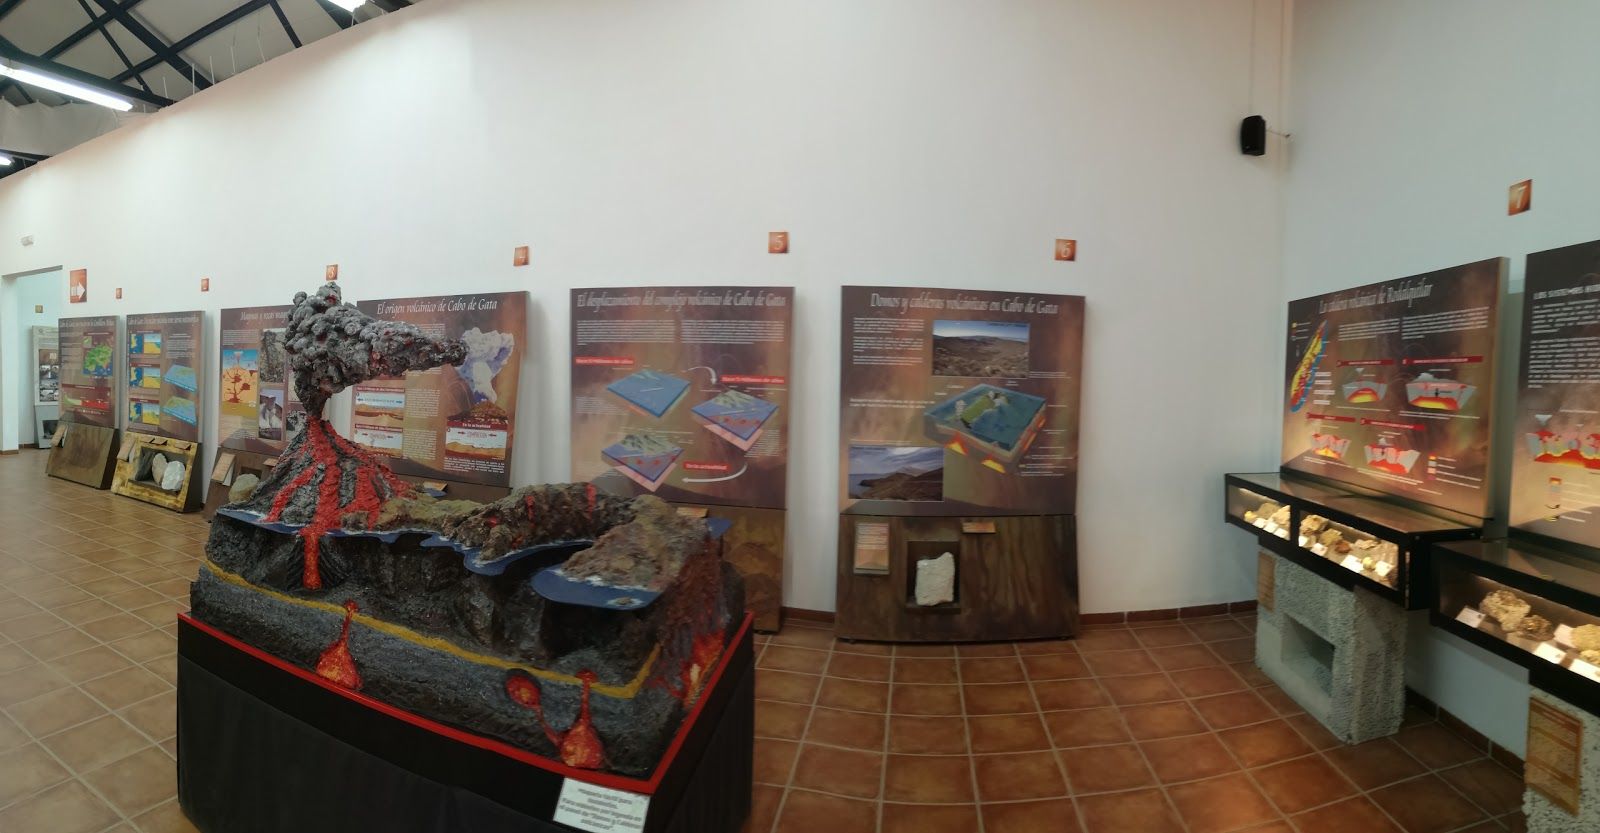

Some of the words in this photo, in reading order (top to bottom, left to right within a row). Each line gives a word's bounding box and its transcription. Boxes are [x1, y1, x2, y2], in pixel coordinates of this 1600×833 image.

[1514, 185, 1528, 208] 7
[774, 234, 784, 250] 5
[1061, 241, 1073, 258] 6
[377, 301, 386, 315] El
[385, 303, 405, 319] origen
[406, 300, 436, 313] volcánico
[437, 298, 447, 312] de
[447, 297, 467, 312] Cabo
[467, 296, 477, 311] de
[478, 298, 498, 311] Gata
[577, 292, 588, 307] El
[641, 290, 656, 305] del
[723, 290, 733, 305] de
[733, 290, 754, 305] Cabo
[754, 290, 765, 305] de
[765, 293, 786, 306] Gata
[871, 293, 900, 307] Domos
[899, 297, 909, 314] y
[909, 291, 945, 309] calderas
[989, 301, 1001, 311] en
[1001, 296, 1025, 312] Cabo
[1025, 297, 1036, 313] de
[1036, 300, 1059, 313] Gata
